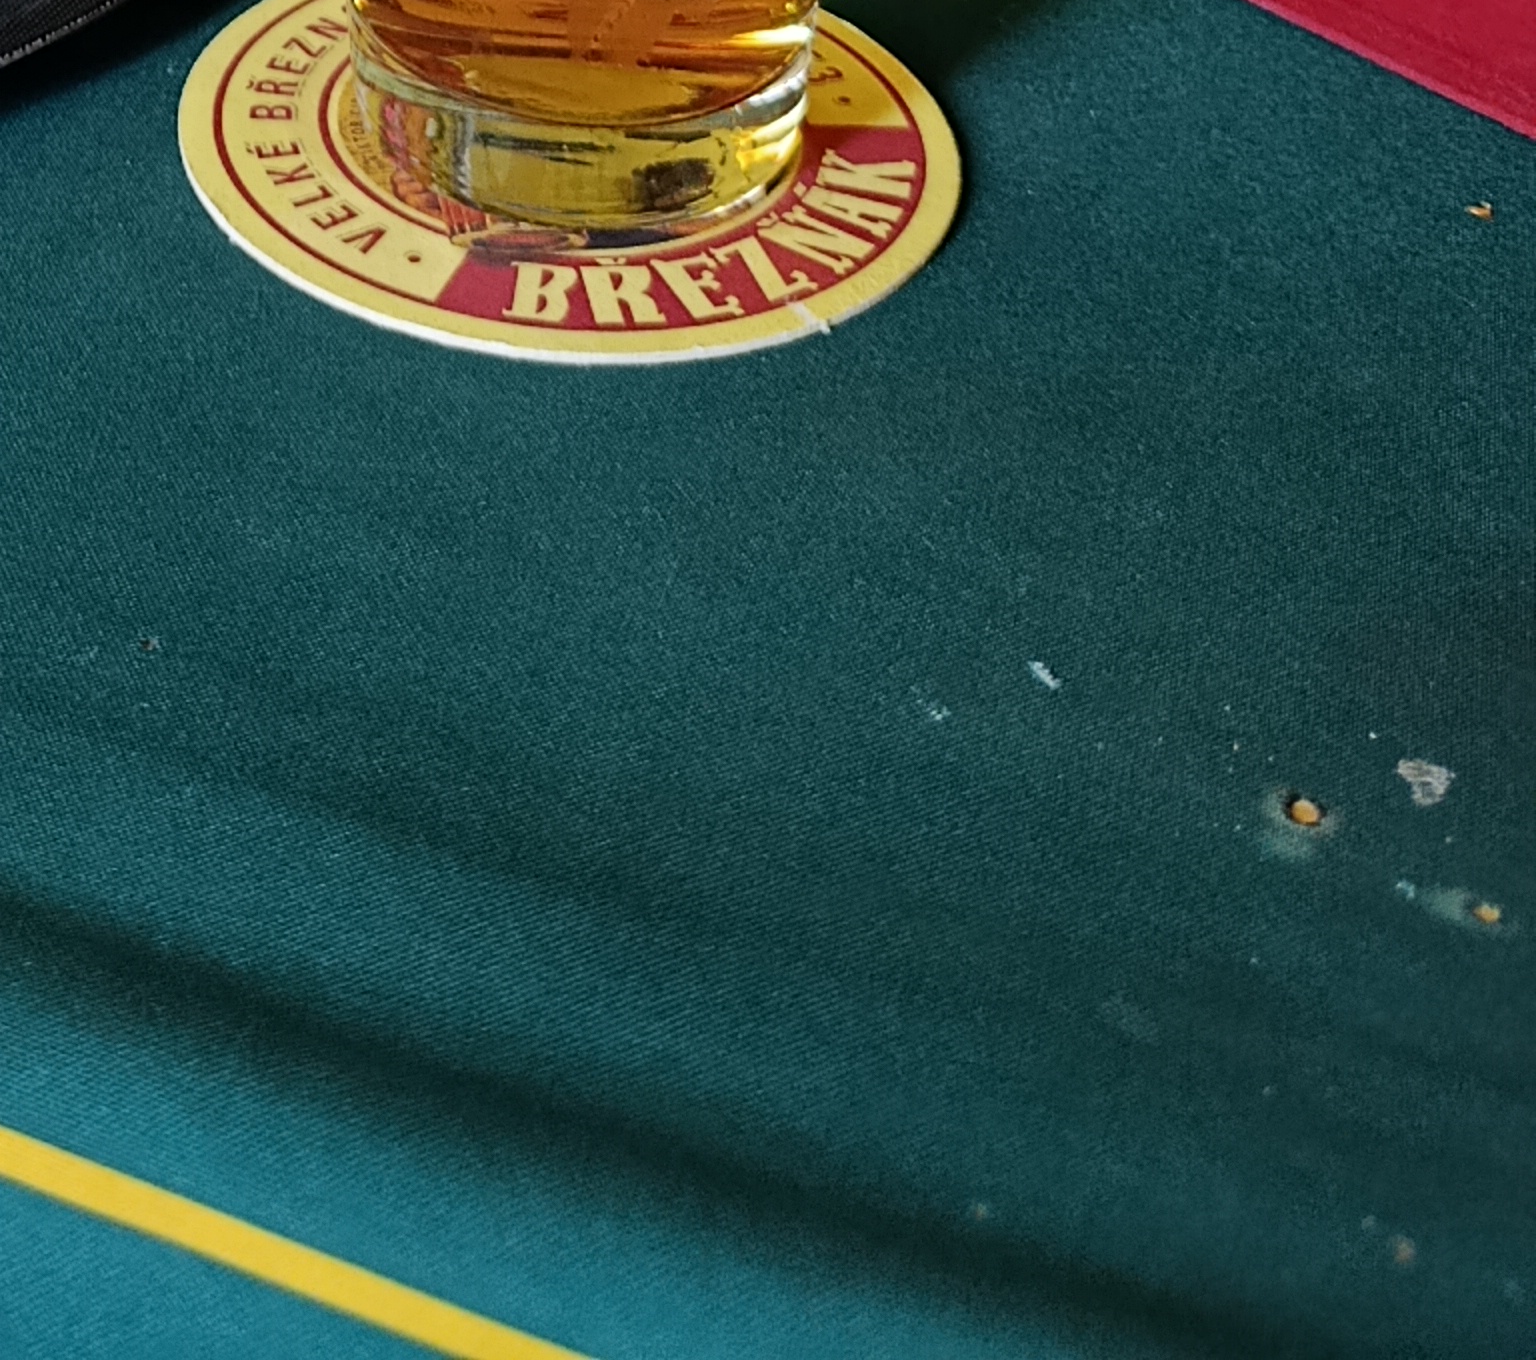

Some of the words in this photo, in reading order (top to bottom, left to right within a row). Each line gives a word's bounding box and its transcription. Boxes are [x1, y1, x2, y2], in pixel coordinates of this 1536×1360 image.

[245, 4, 349, 120] BŘEZN
[246, 138, 386, 256] VELKÉ
[502, 149, 918, 329] BŘEZŇÁK
